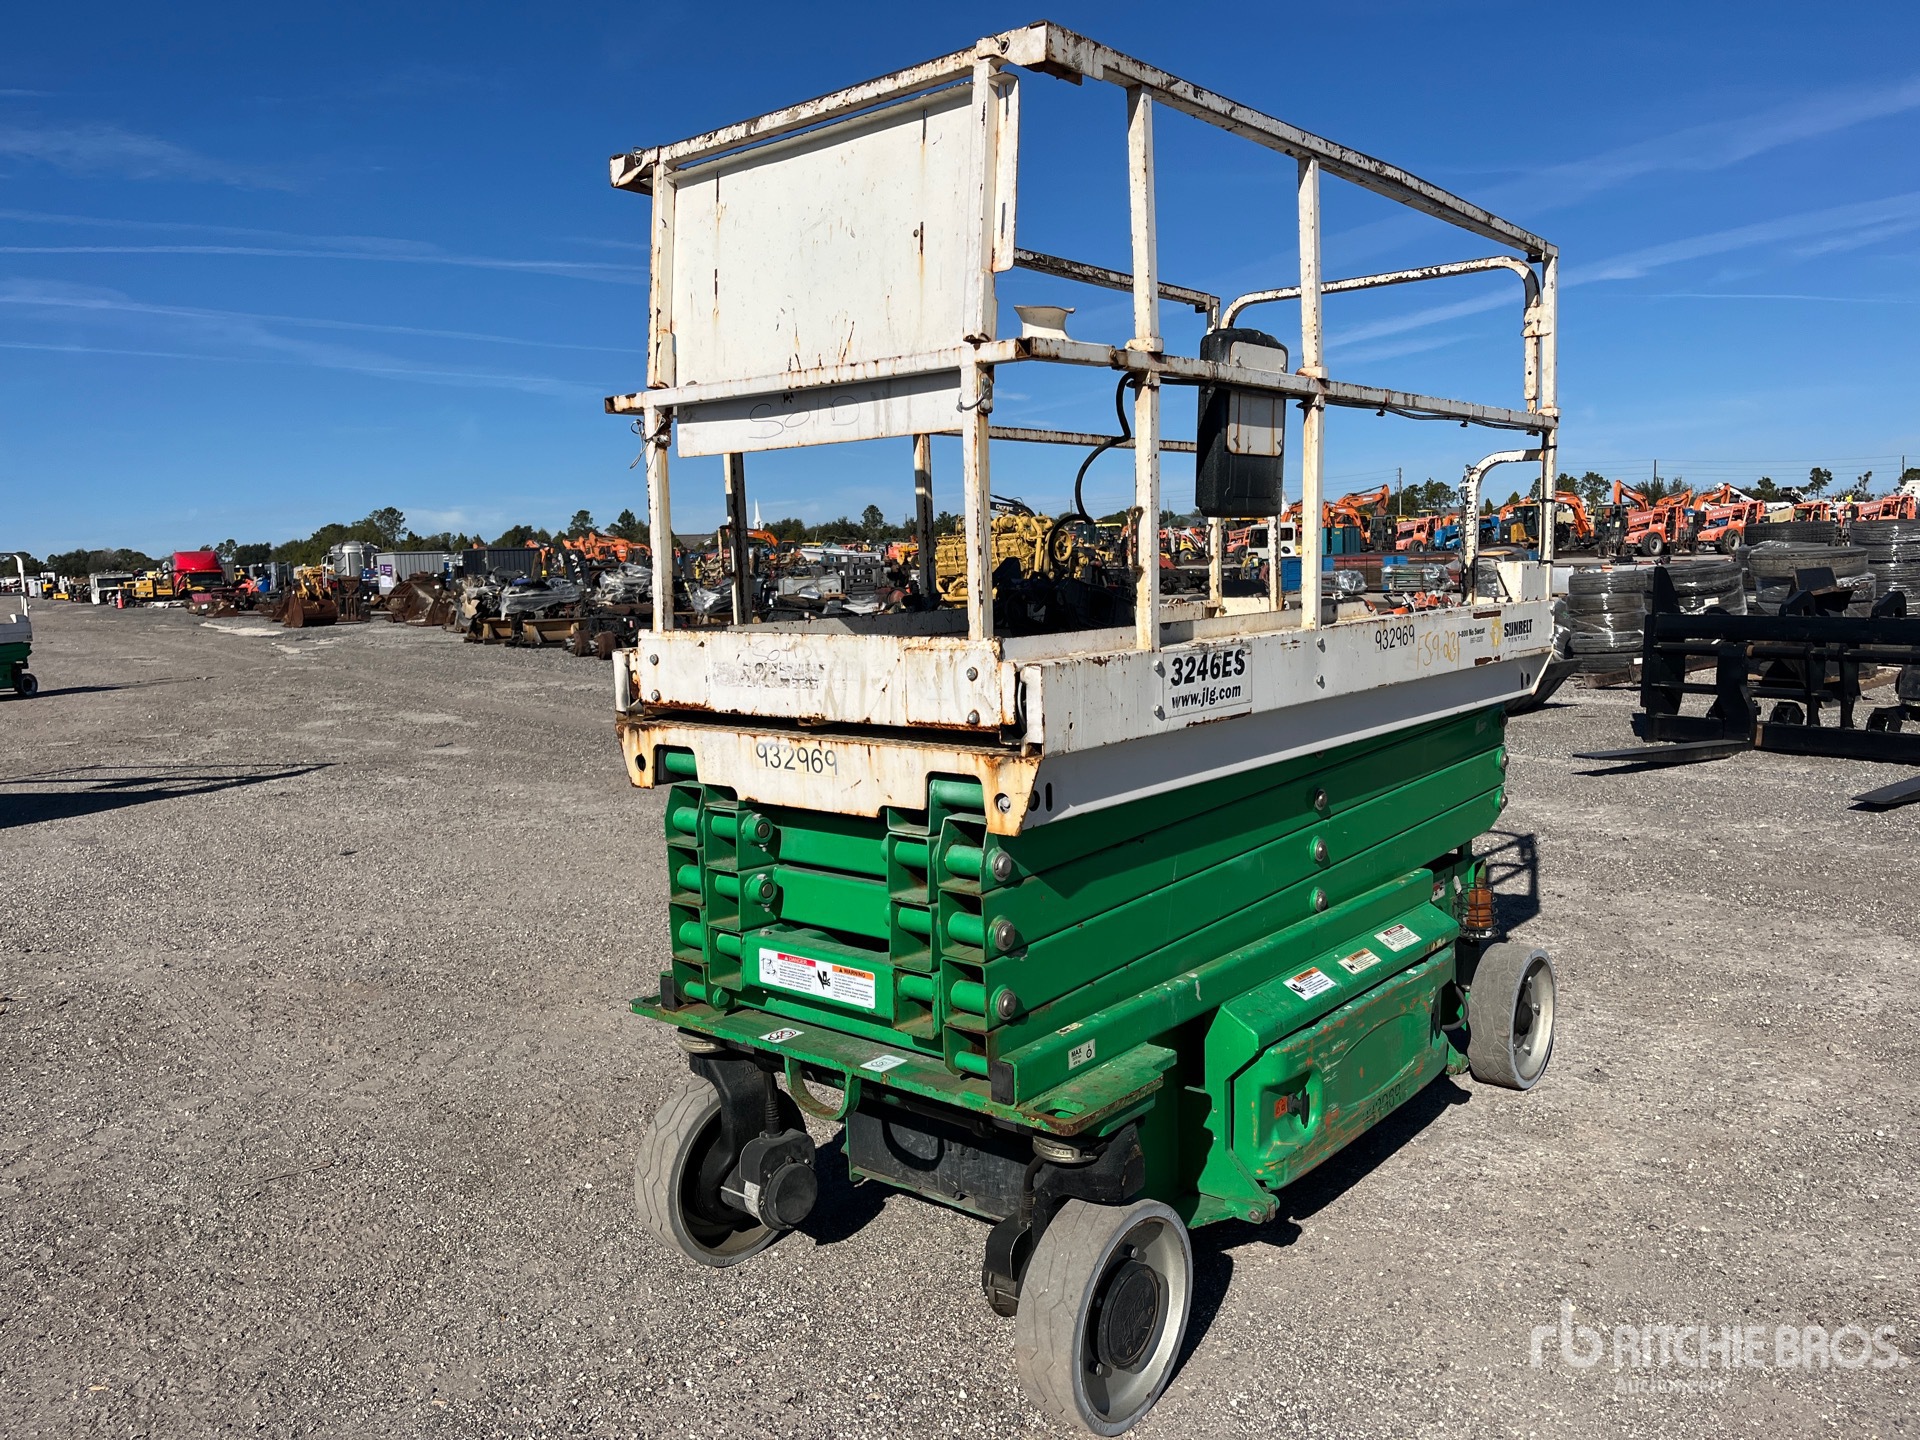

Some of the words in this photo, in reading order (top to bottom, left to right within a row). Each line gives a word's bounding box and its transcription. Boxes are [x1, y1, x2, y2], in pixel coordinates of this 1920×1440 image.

[1375, 624, 1415, 650] 932969
[1504, 619, 1533, 637] SUNBELT
[1170, 648, 1246, 687] 3246ES
[1171, 685, 1242, 709] www.jlg.com
[756, 743, 838, 776] 932969
[788, 956, 808, 966] DANGER
[843, 968, 866, 979] WARNING
[1071, 1047, 1082, 1058] MAX
